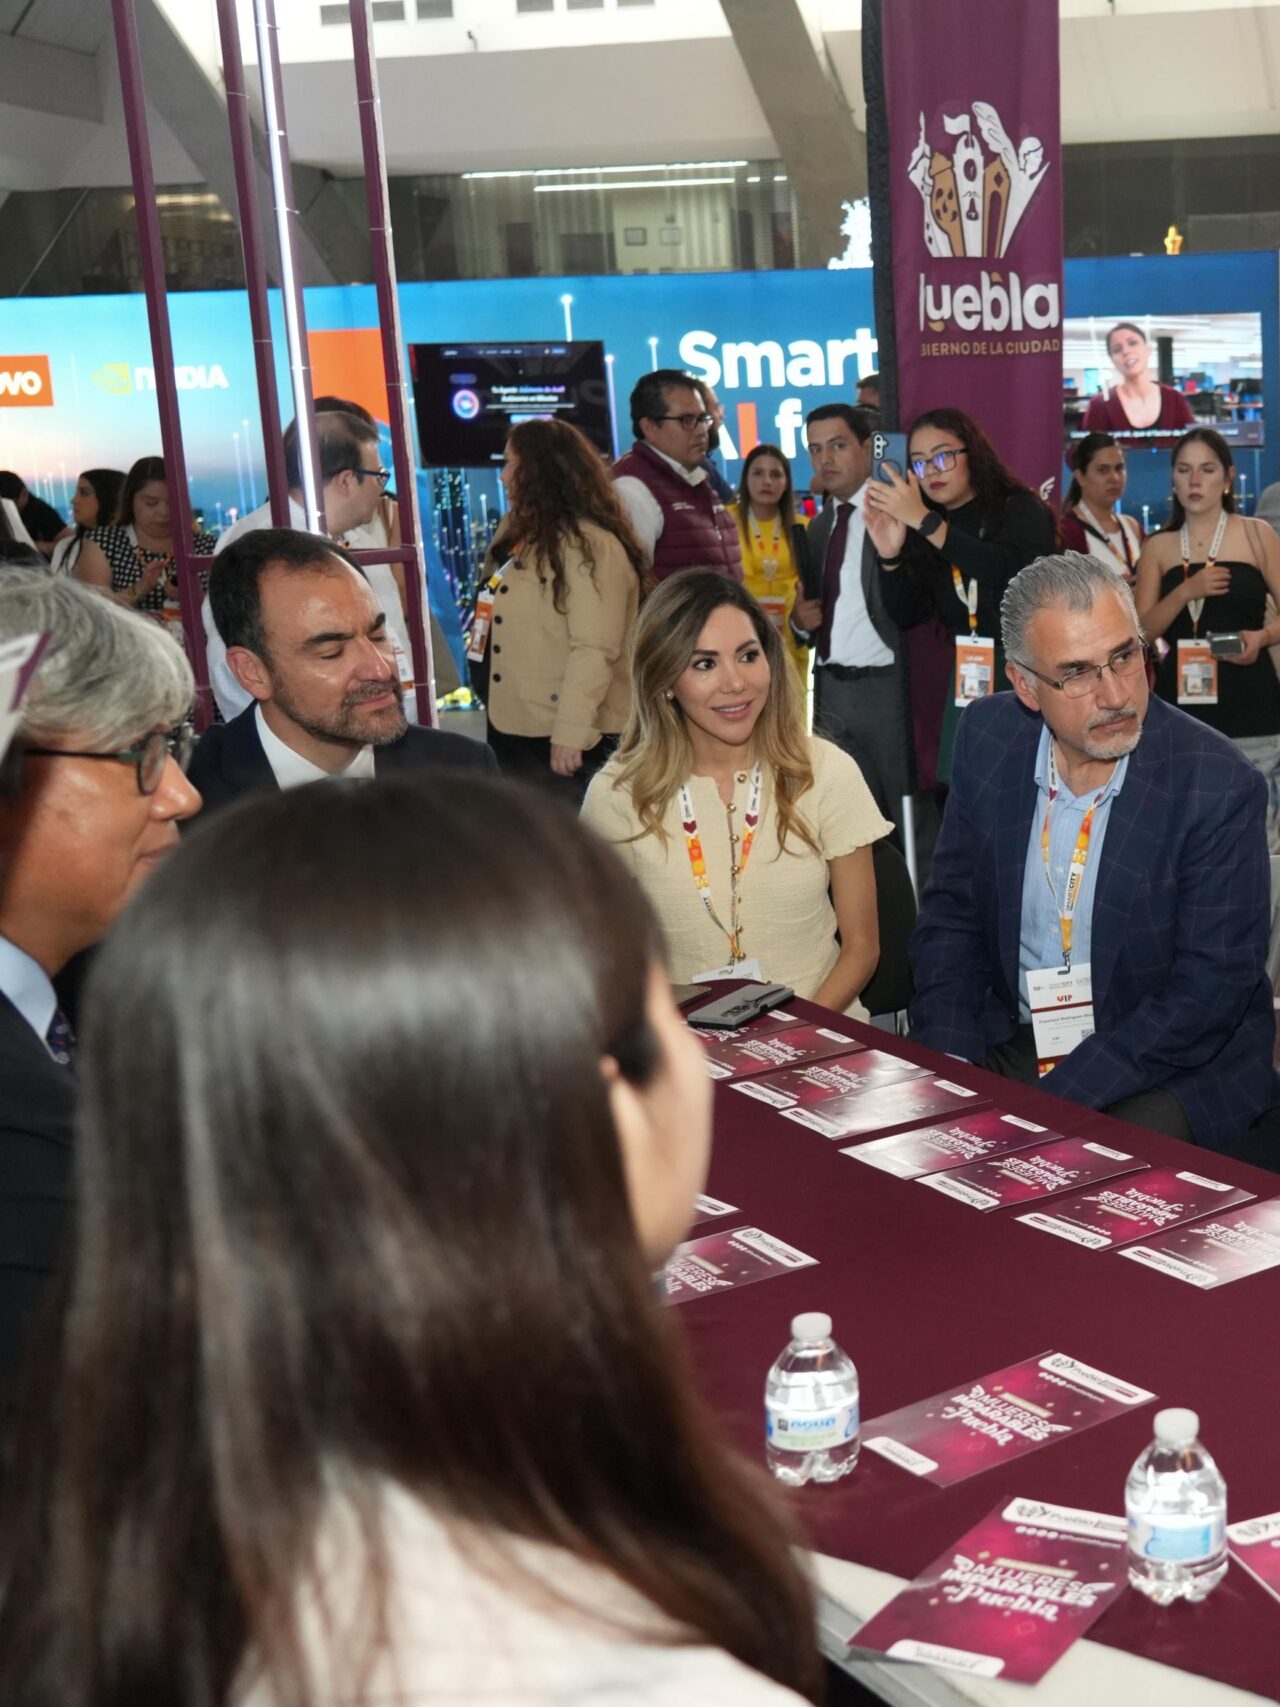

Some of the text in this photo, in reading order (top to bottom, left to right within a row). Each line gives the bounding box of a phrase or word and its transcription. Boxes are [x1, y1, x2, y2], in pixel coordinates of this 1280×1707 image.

[679, 327, 880, 389] Smart
[972, 341, 987, 355] DE
[989, 340, 1005, 355] LA
[1005, 338, 1061, 355] CIUDAD
[1056, 993, 1073, 1002] VIP
[949, 1406, 1014, 1447] Puebla
[951, 1393, 1050, 1441] IMPARABLES
[980, 1393, 1050, 1429] MUJERES
[939, 1567, 1098, 1608] IMPARABLES
[973, 1562, 1085, 1593] MUJERES
[947, 1583, 1059, 1622] Puebla
